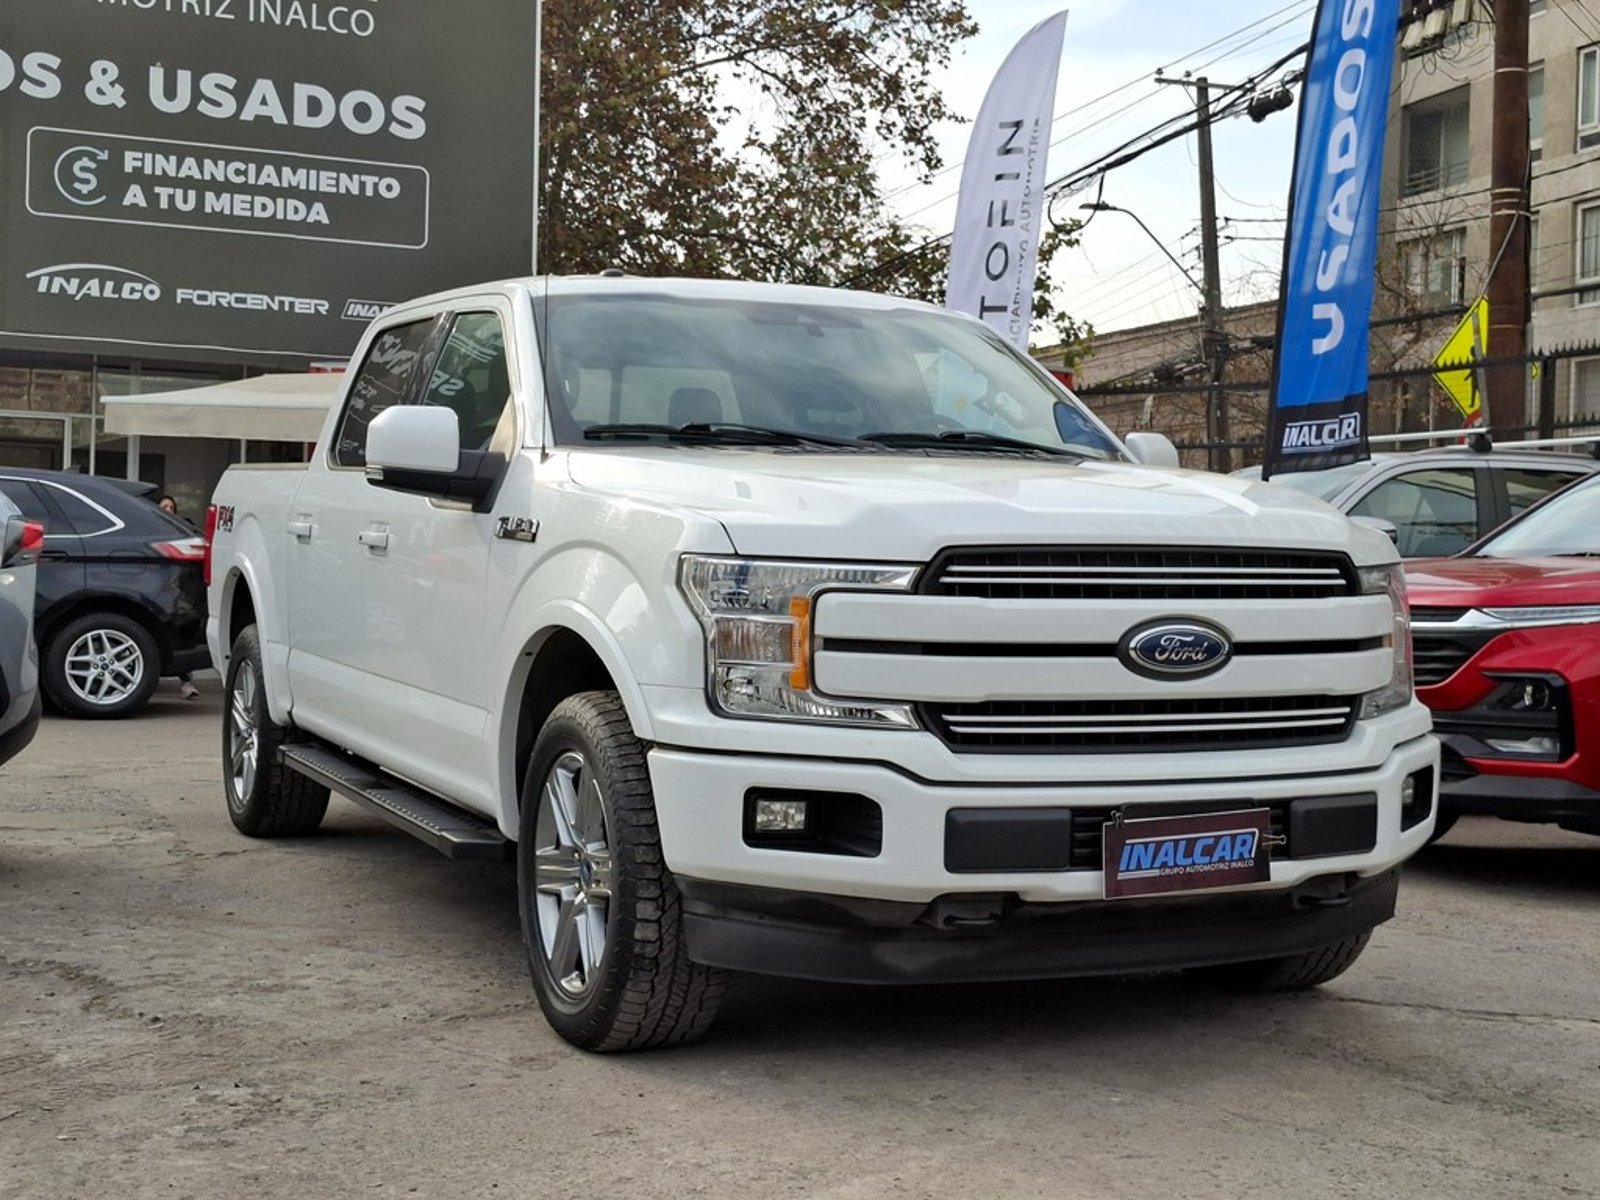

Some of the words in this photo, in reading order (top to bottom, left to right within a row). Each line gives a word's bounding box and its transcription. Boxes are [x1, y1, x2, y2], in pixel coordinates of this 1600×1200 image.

[97, 0, 235, 20] RIZ
[249, 0, 375, 37] INALCO
[84, 60, 127, 109] &
[149, 64, 427, 140] USADOS
[124, 151, 401, 199] FINANCIAMIENTO
[1312, 0, 1375, 355] USADOS
[122, 184, 148, 208] A
[154, 187, 197, 212] TU
[204, 191, 331, 225] MEDIDA
[37, 275, 161, 301] INALCO
[176, 288, 330, 315] FORCENTER
[347, 303, 387, 317] INA
[1155, 635, 1209, 661] Ford
[1119, 833, 1254, 871] INALCAR
